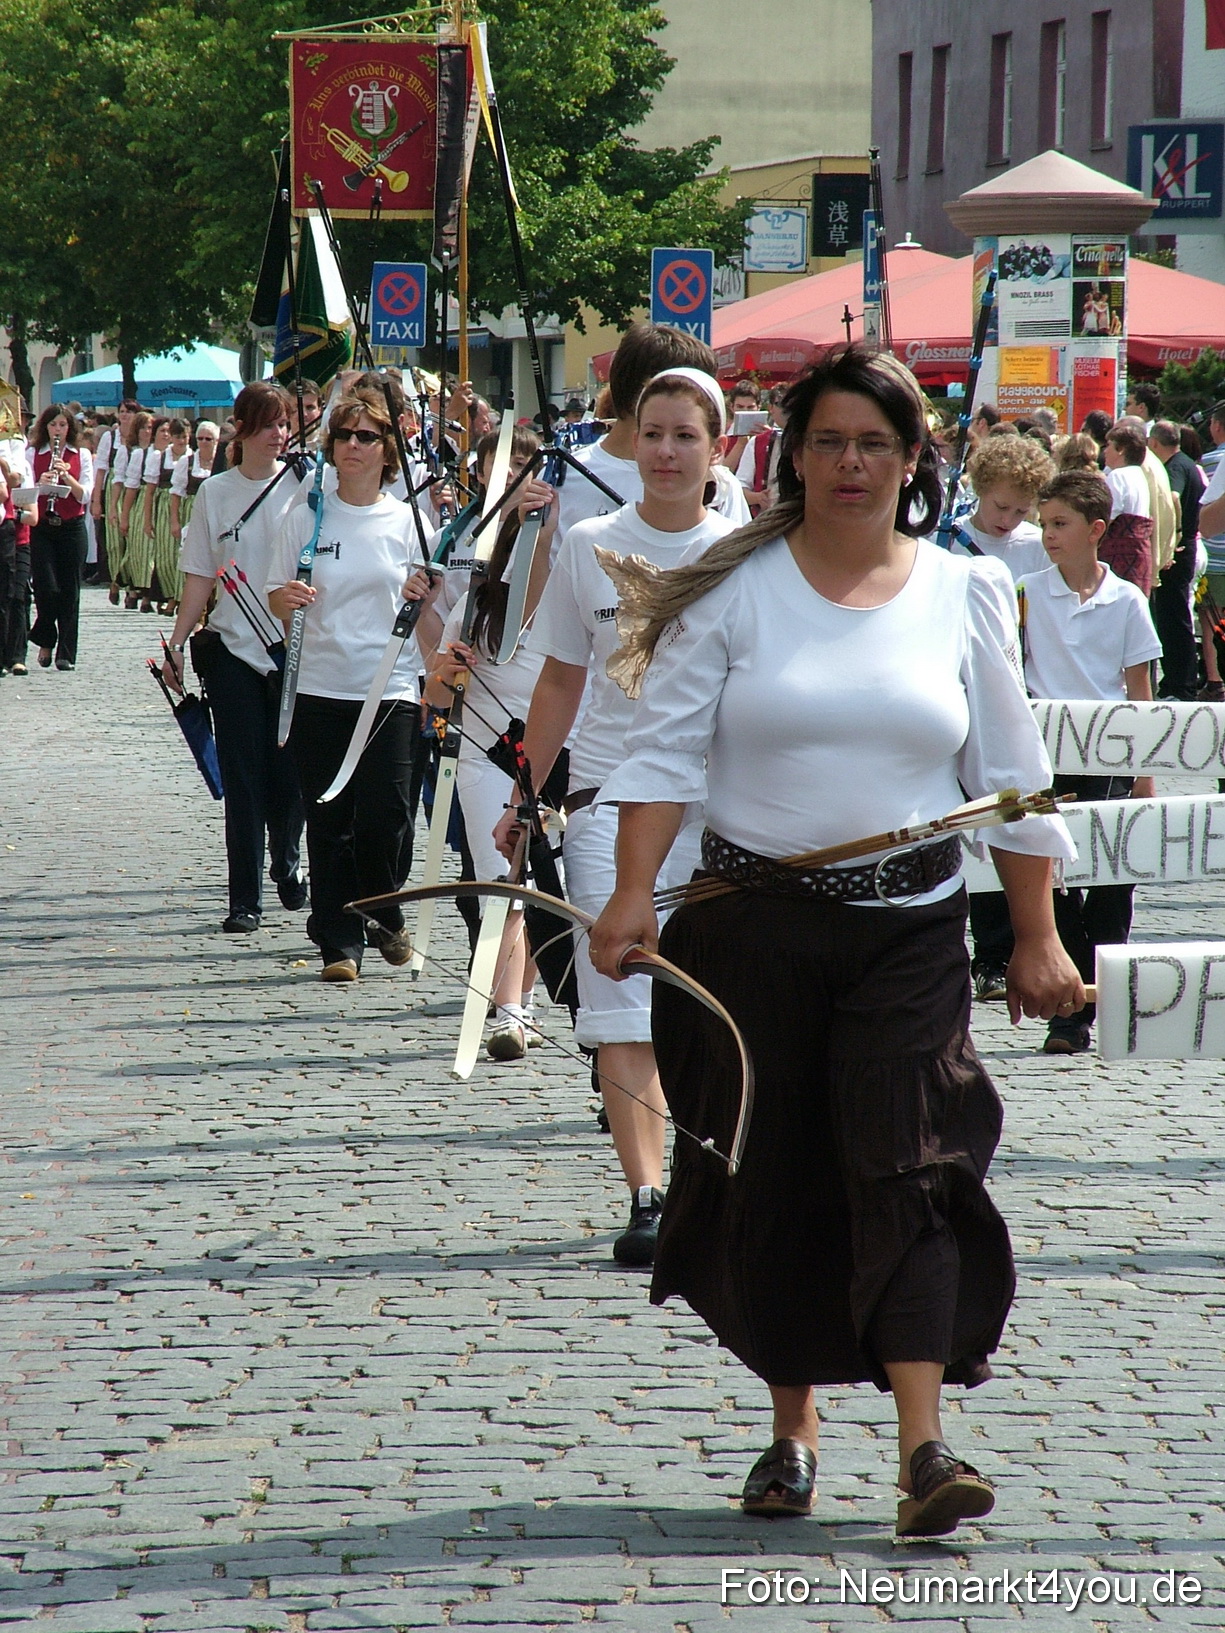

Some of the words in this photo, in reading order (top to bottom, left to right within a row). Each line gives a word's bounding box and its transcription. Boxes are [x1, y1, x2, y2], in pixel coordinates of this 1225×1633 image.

[331, 63, 385, 87] verbindet
[388, 65, 405, 82] die
[1161, 199, 1210, 209] RUPPERT
[376, 321, 420, 340] TAXI
[1158, 347, 1195, 360] Hotel
